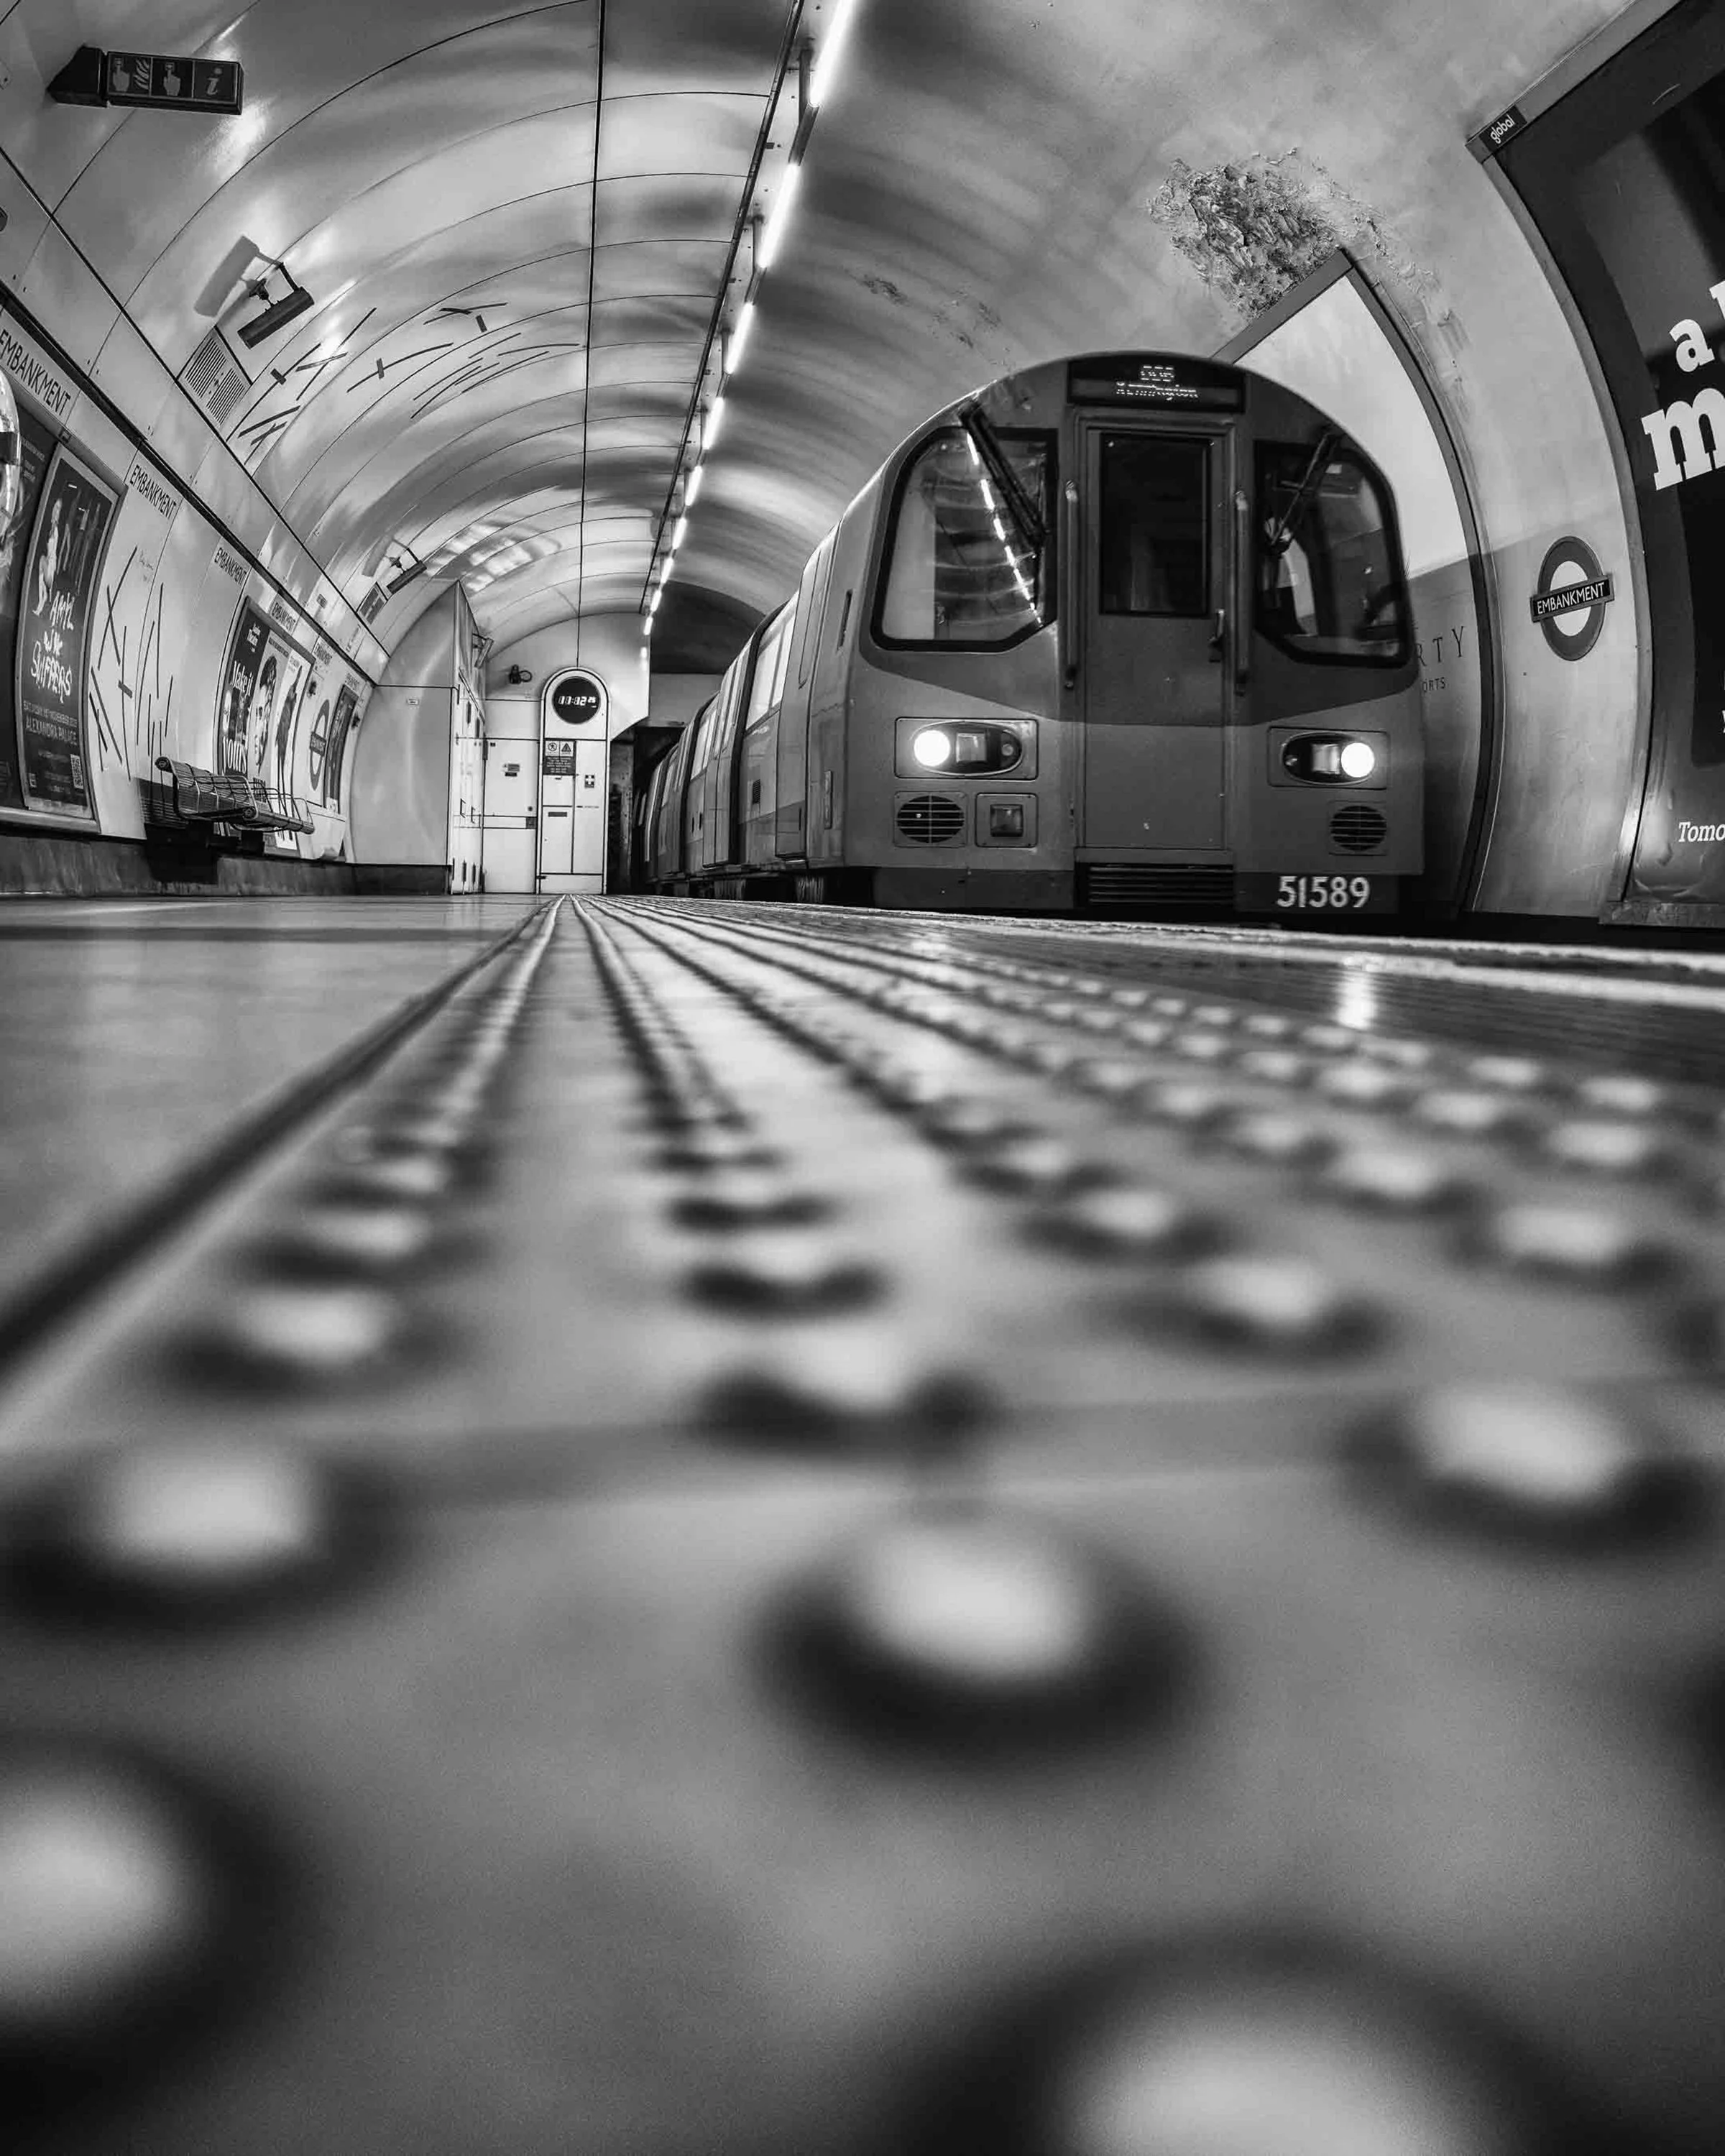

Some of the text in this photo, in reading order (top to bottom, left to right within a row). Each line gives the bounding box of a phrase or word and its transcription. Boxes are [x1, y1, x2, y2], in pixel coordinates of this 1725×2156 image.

[1490, 114, 1515, 144] global
[1669, 318, 1715, 372] a
[0, 329, 70, 416] EMBANKMENT
[130, 464, 177, 520] EMBANKMENT
[214, 547, 247, 586] EMBANKMENT
[1537, 581, 1604, 614] EMBANKMENT
[229, 660, 248, 694] Make
[221, 735, 247, 777] yours
[1276, 875, 1371, 908] 51589
